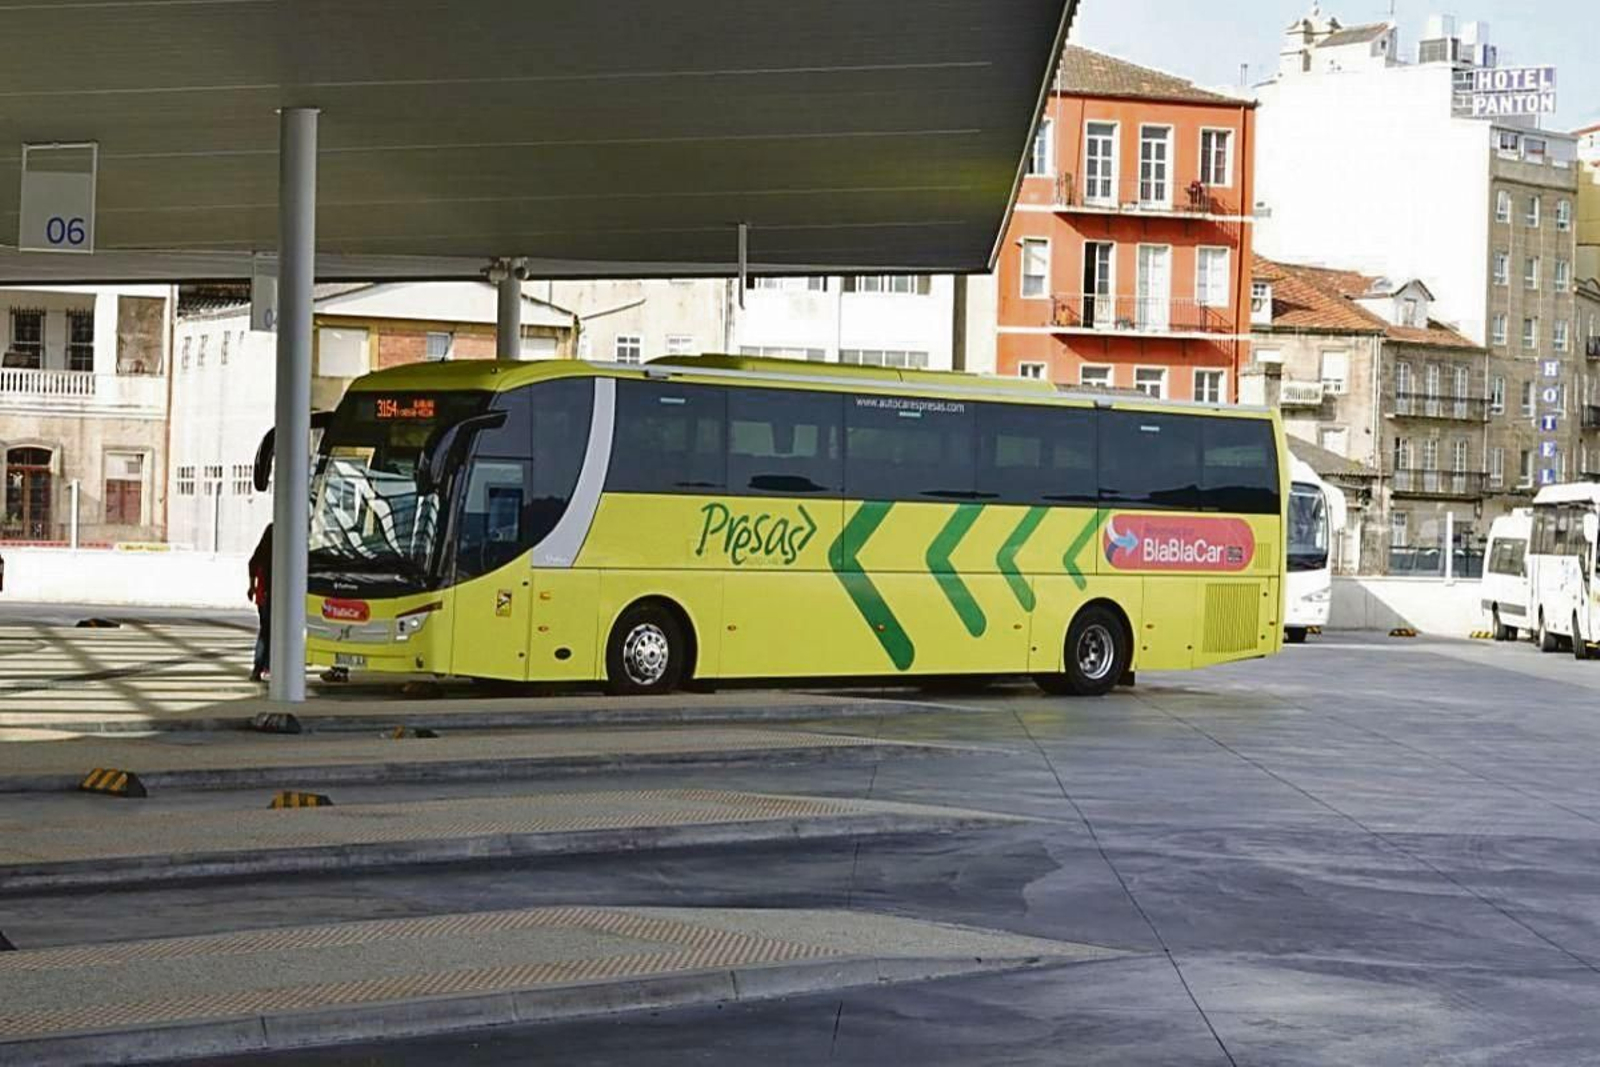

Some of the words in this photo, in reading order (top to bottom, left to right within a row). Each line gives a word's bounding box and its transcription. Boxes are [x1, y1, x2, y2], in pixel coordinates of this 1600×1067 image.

[1478, 69, 1552, 89] HOTEL
[1474, 93, 1554, 113] PANTON
[46, 217, 85, 245] 06
[853, 395, 965, 414] www.autocarespresas.com
[1541, 360, 1557, 484] HOTEL
[695, 502, 804, 565] Presas
[1143, 537, 1225, 562] BlaBlaCar
